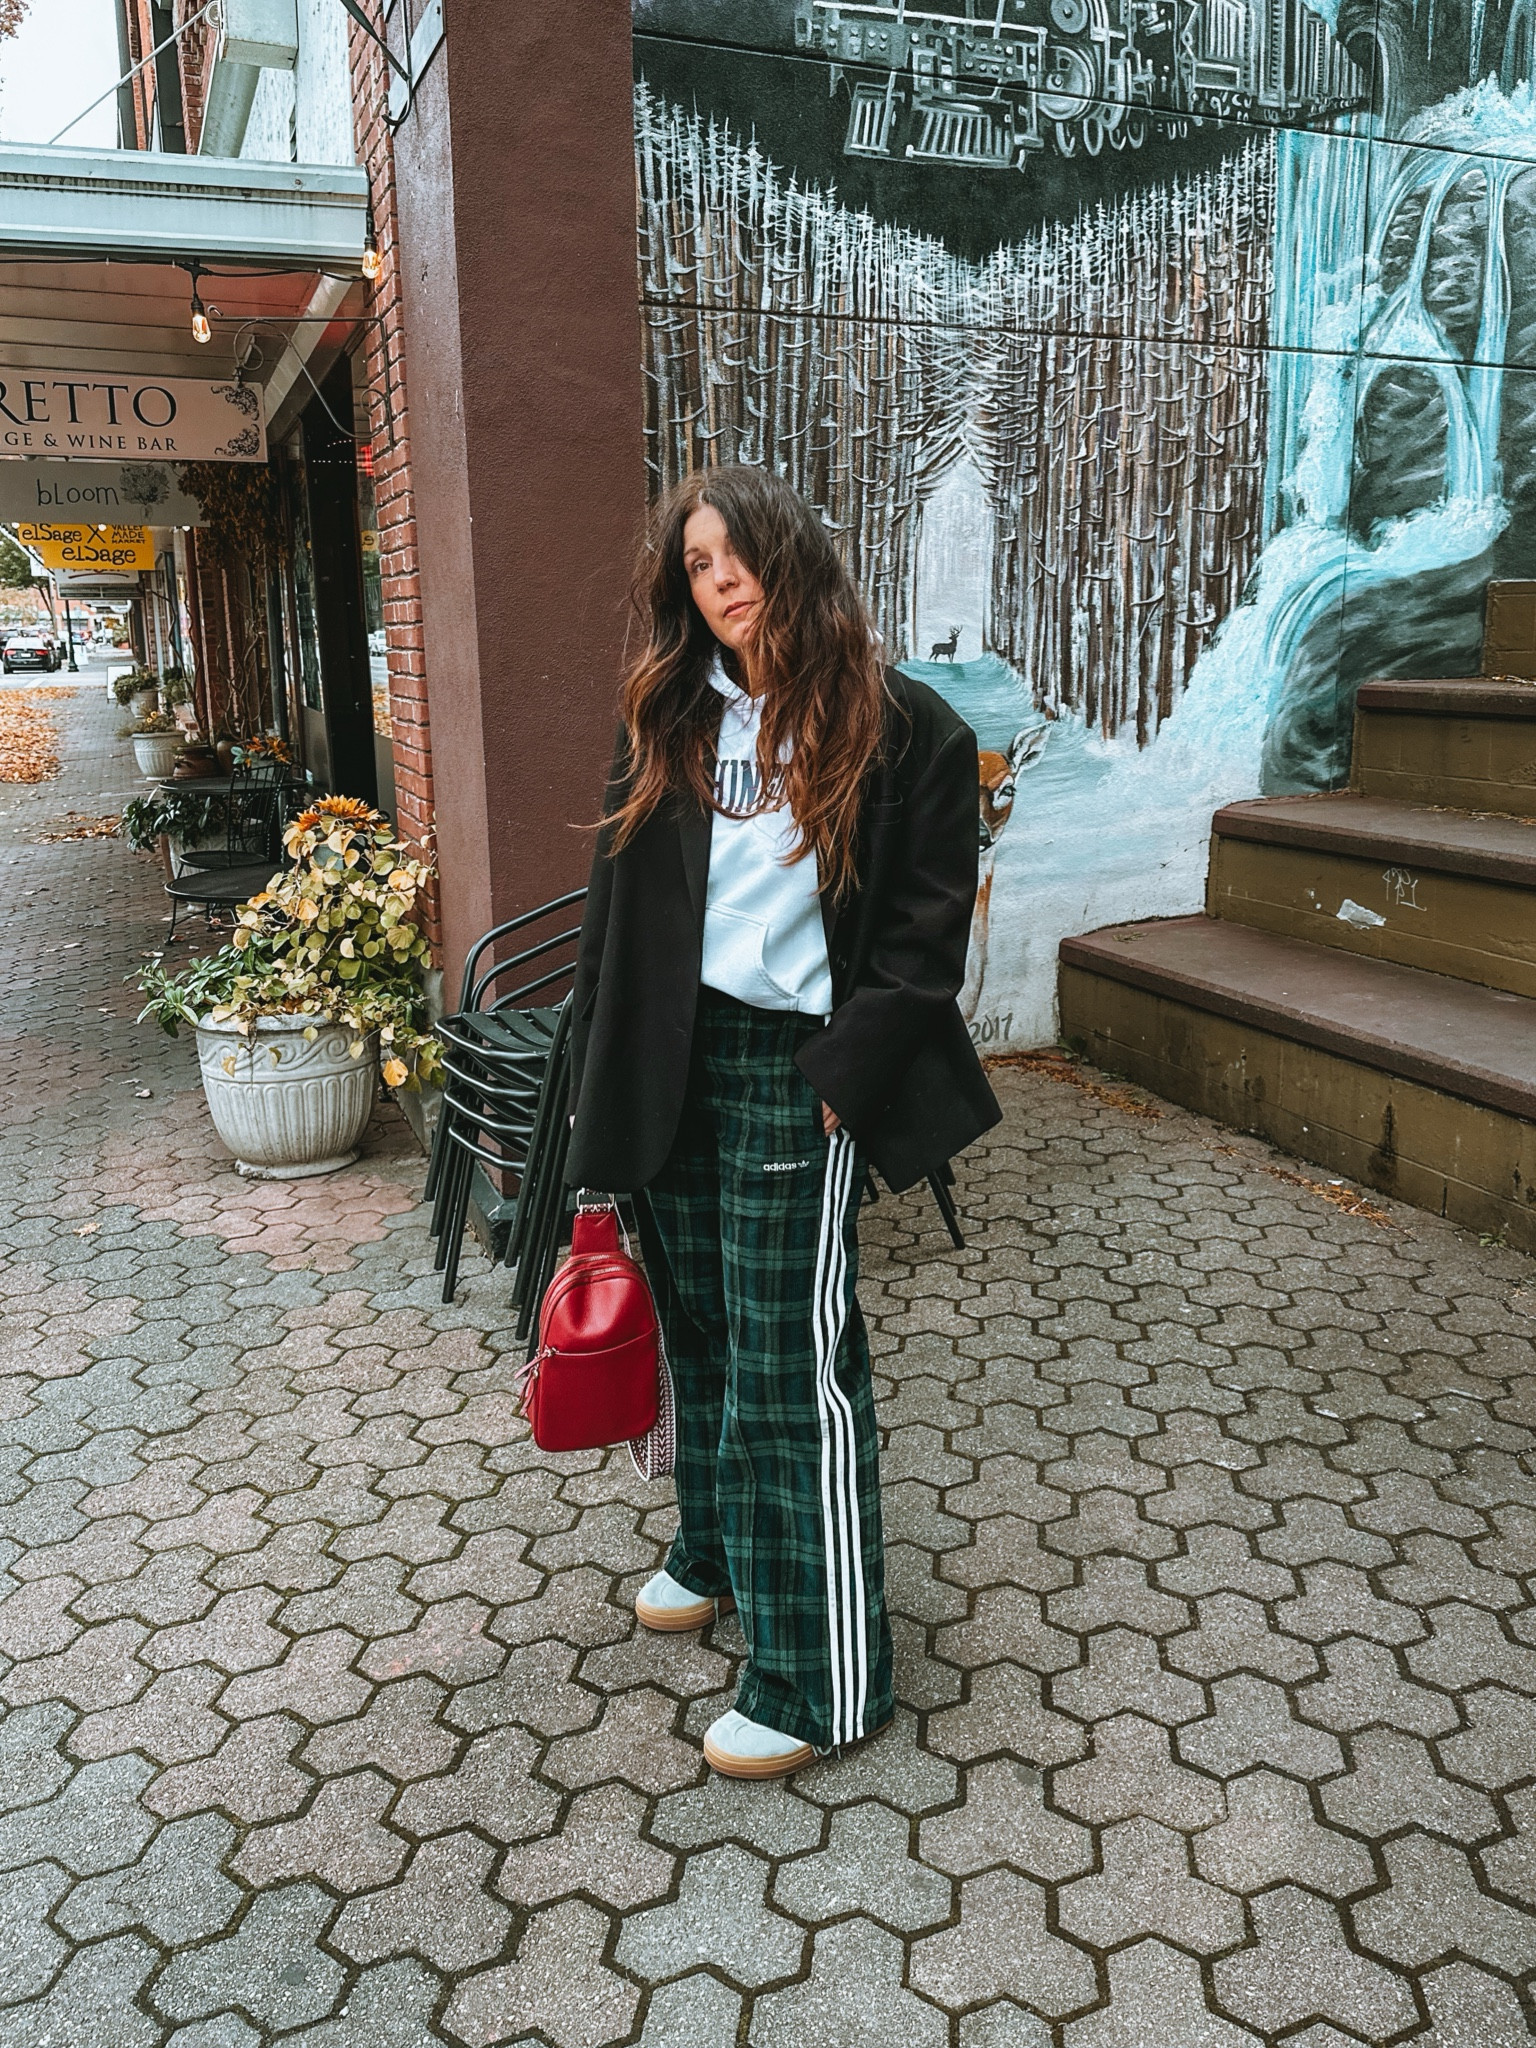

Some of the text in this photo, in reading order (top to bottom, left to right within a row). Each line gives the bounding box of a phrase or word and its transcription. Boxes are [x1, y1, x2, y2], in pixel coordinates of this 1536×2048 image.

[43, 433, 59, 447] &
[66, 434, 127, 449] WINE
[137, 437, 178, 451] BAR
[968, 1012, 1013, 1047] 2017
[763, 1162, 797, 1171] adidas
